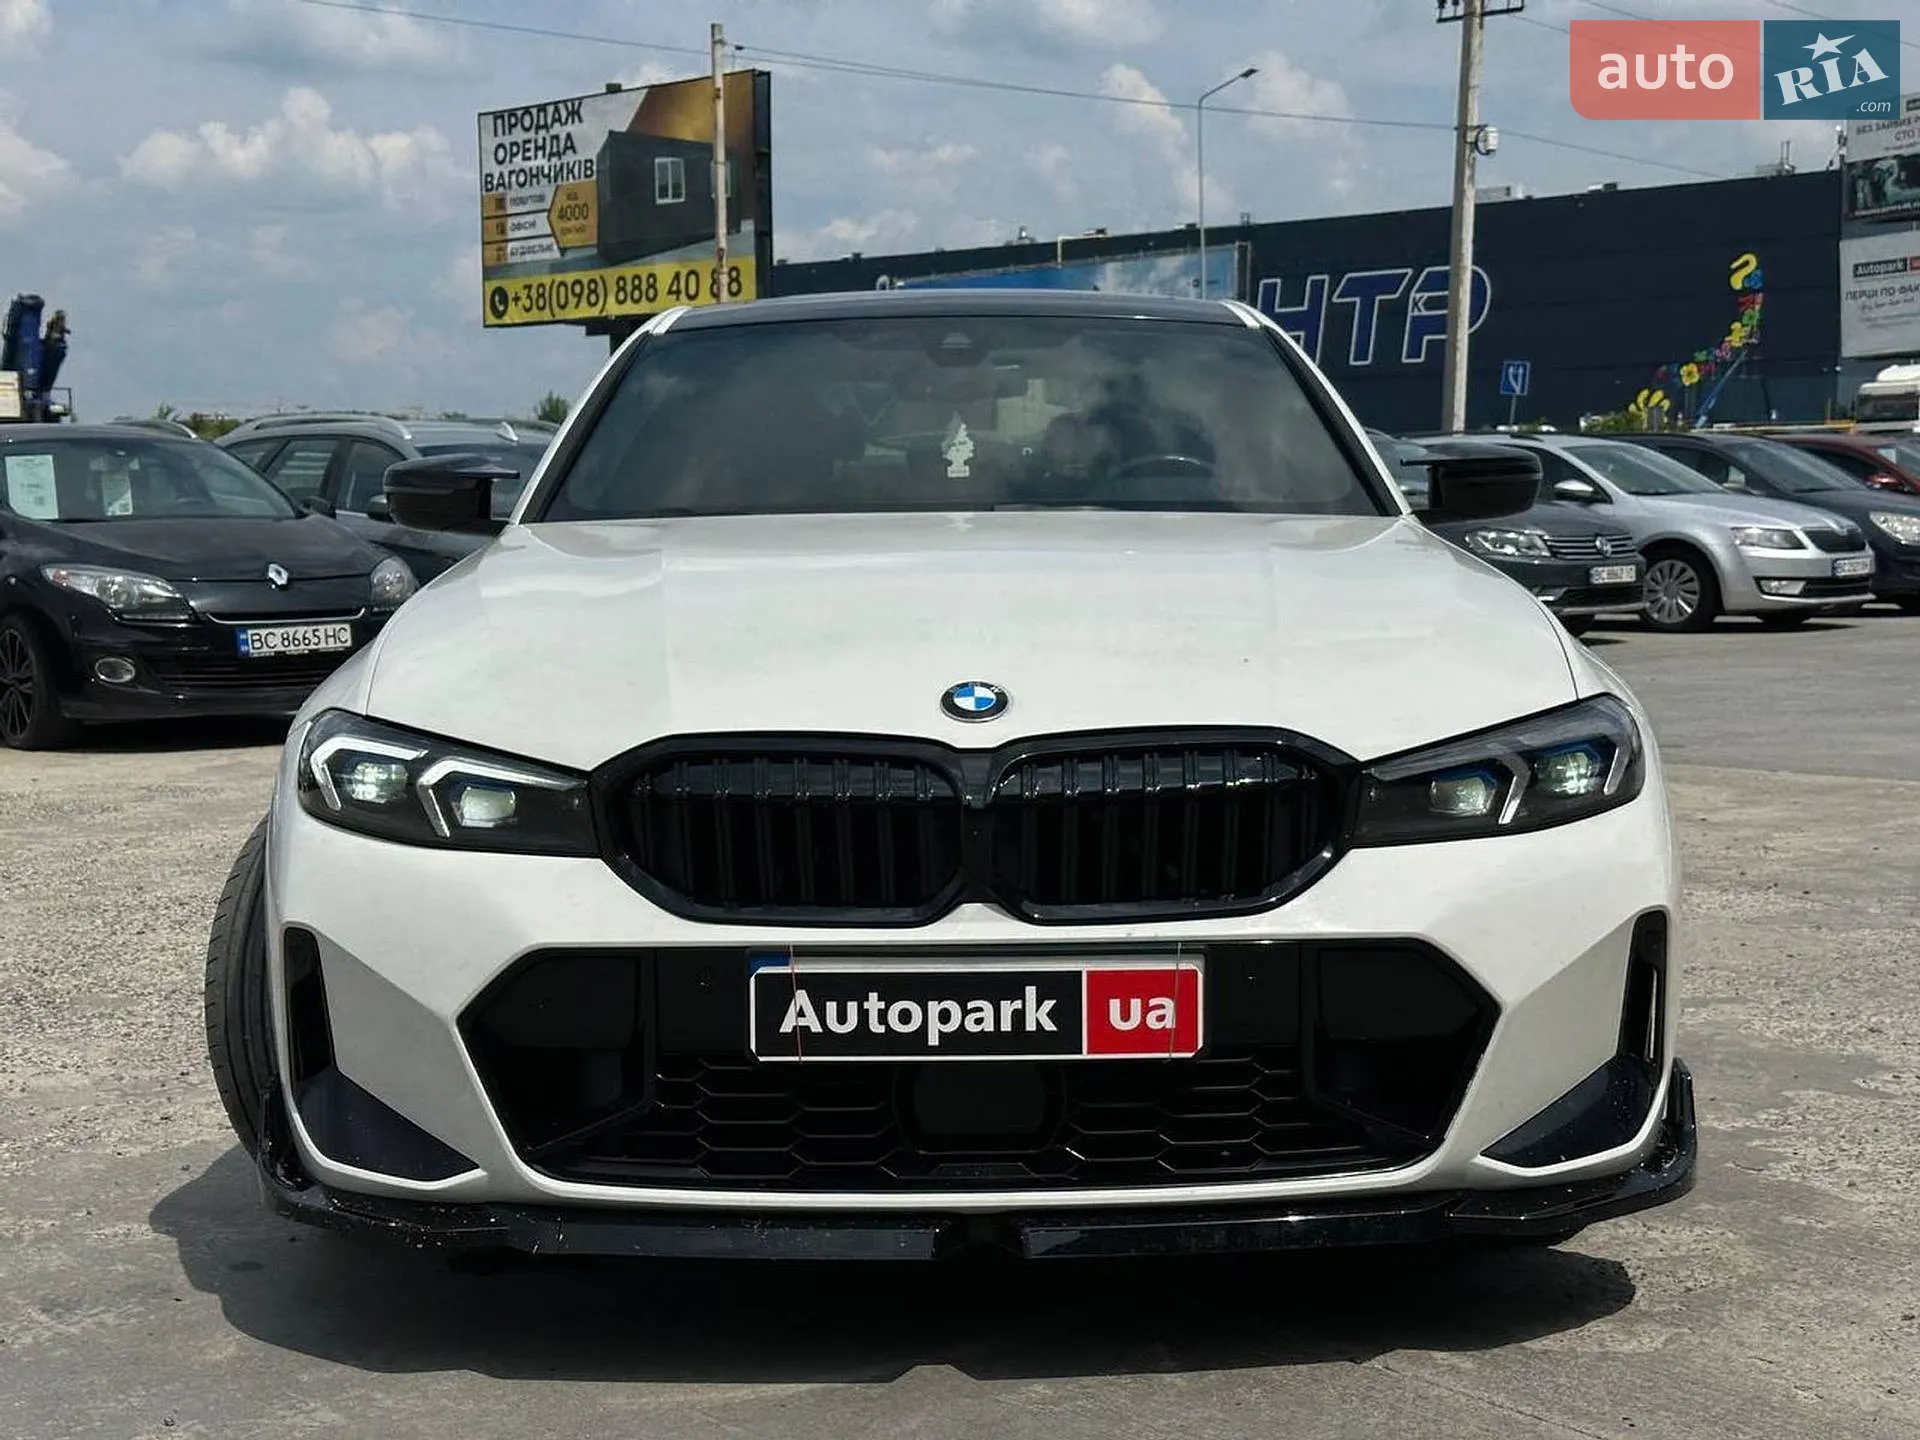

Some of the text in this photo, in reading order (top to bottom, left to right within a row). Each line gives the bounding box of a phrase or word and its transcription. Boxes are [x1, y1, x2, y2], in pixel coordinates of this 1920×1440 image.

[492, 101, 584, 138] ПРОДАЖ
[494, 133, 577, 166] ОРЕНДА
[484, 158, 594, 193] ВАГОНЧИКІВ
[557, 202, 589, 221] 4000
[1856, 260, 1904, 275] Autopark
[512, 272, 607, 318] +38(098)
[615, 271, 658, 305] 888
[667, 269, 700, 300] 40
[250, 626, 348, 650] BC 8665 HC
[779, 985, 1176, 1047] Autopark ua
